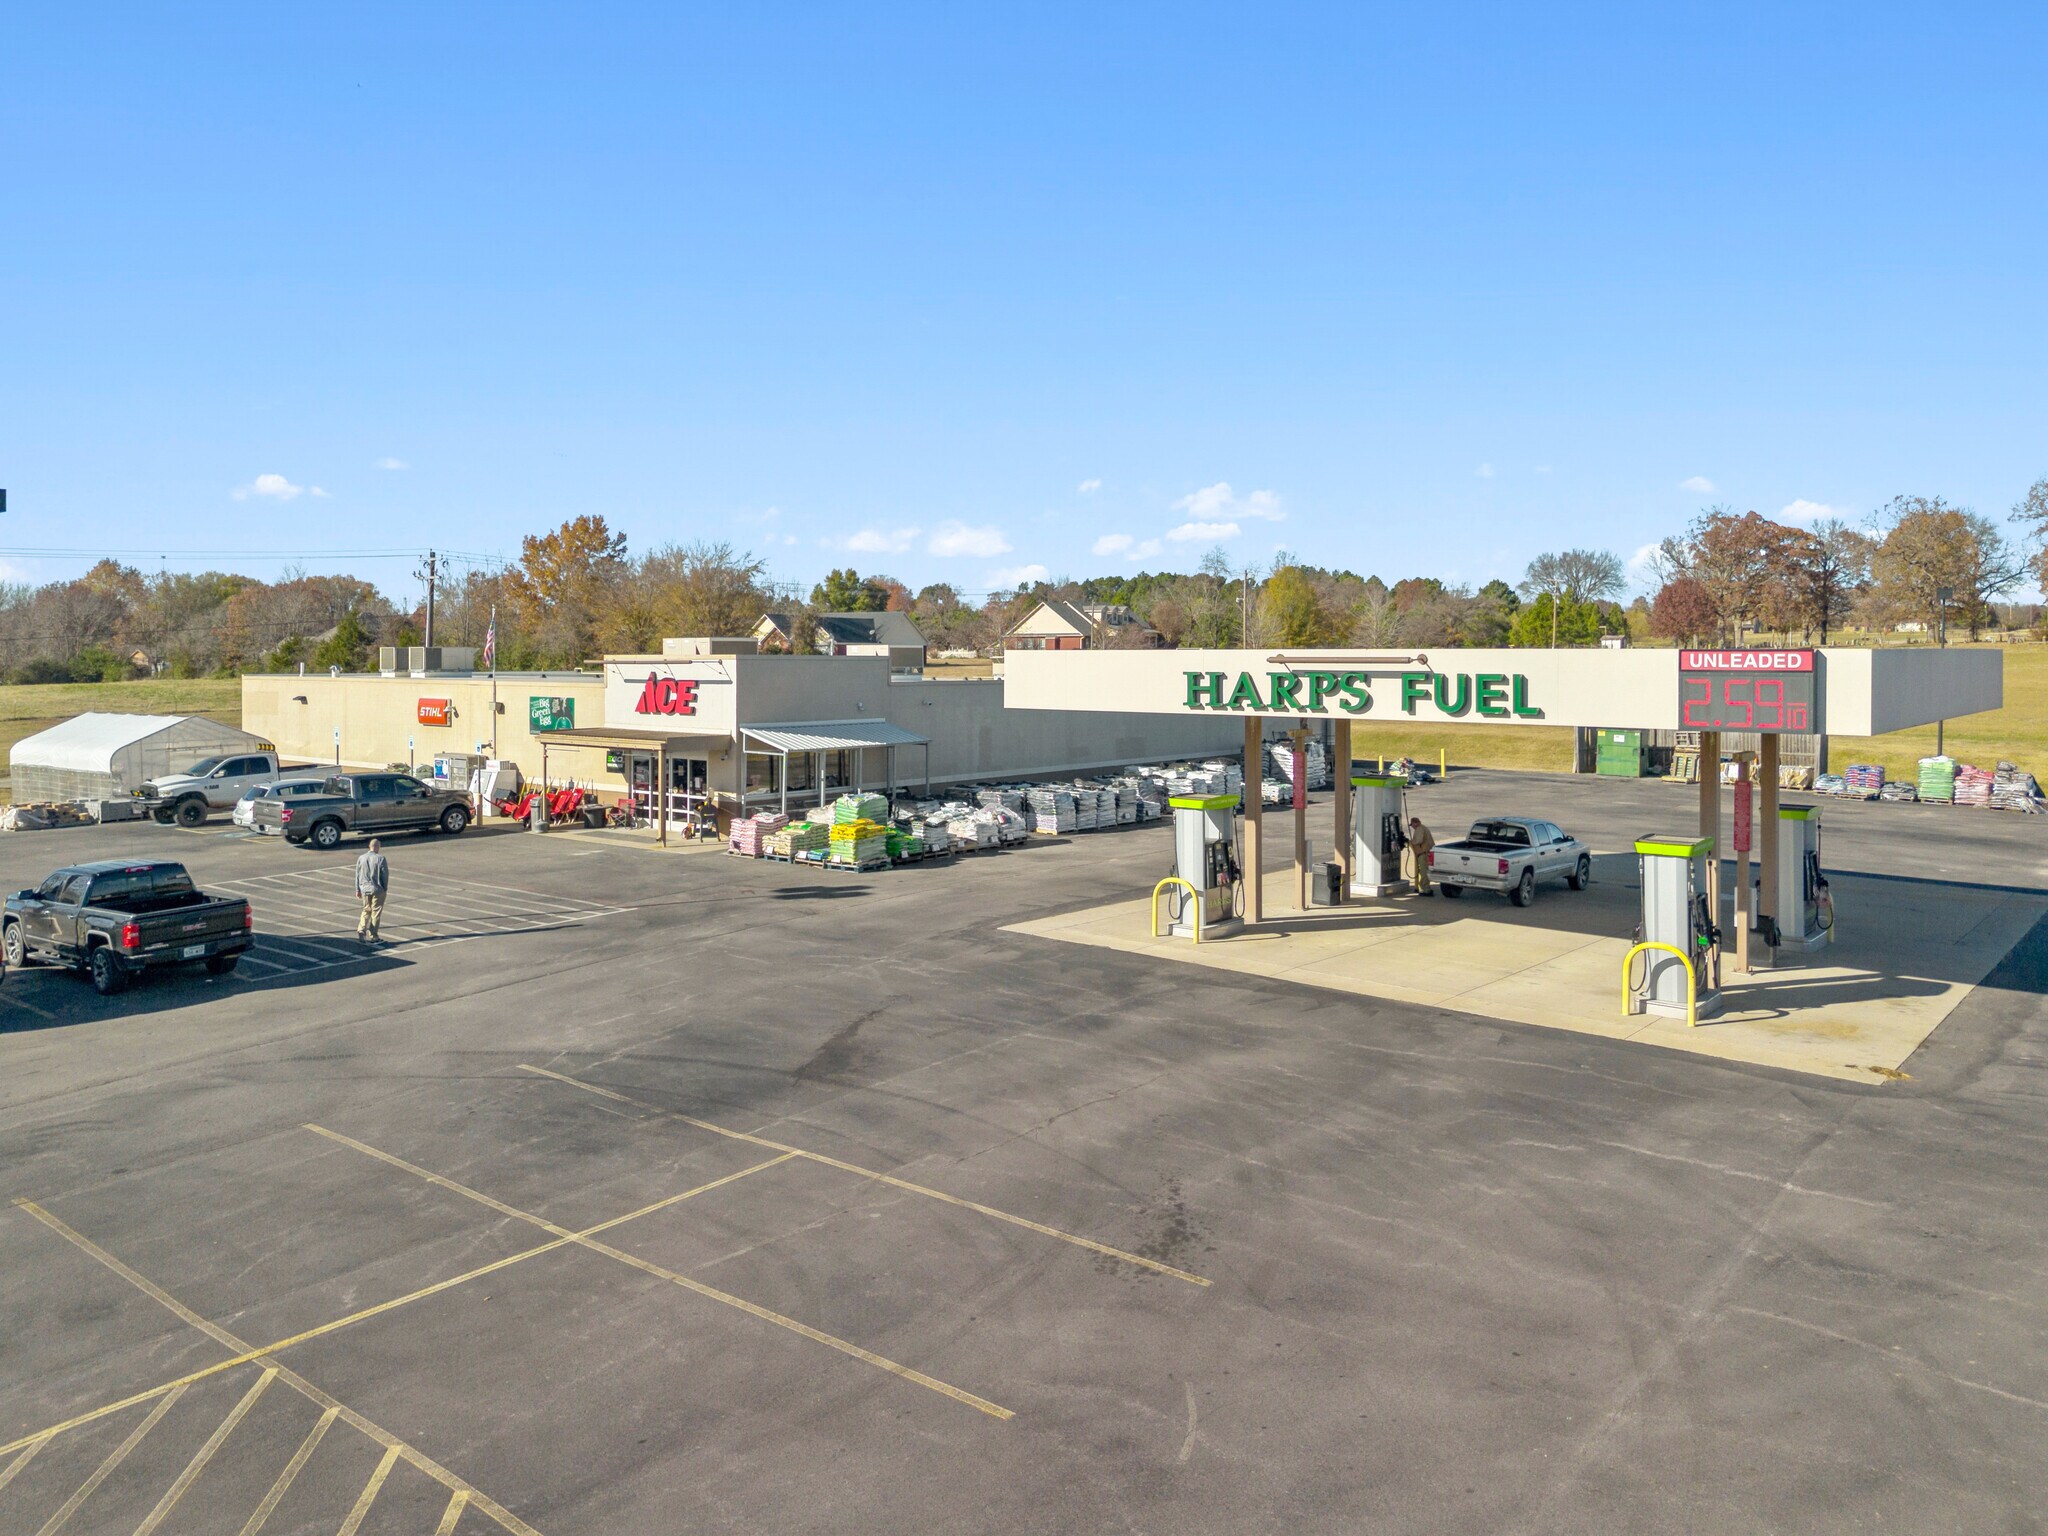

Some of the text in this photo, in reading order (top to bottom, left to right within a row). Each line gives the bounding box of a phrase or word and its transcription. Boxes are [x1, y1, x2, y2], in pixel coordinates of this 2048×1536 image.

[1689, 653, 1802, 669] UNLEADED
[635, 672, 698, 715] ACE
[1182, 671, 1543, 715] HARPS FUEL
[539, 698, 550, 708] Big
[1683, 677, 1784, 729] 2.59
[419, 706, 442, 717] STIHL
[531, 707, 551, 718] Green
[539, 715, 551, 726] Egg
